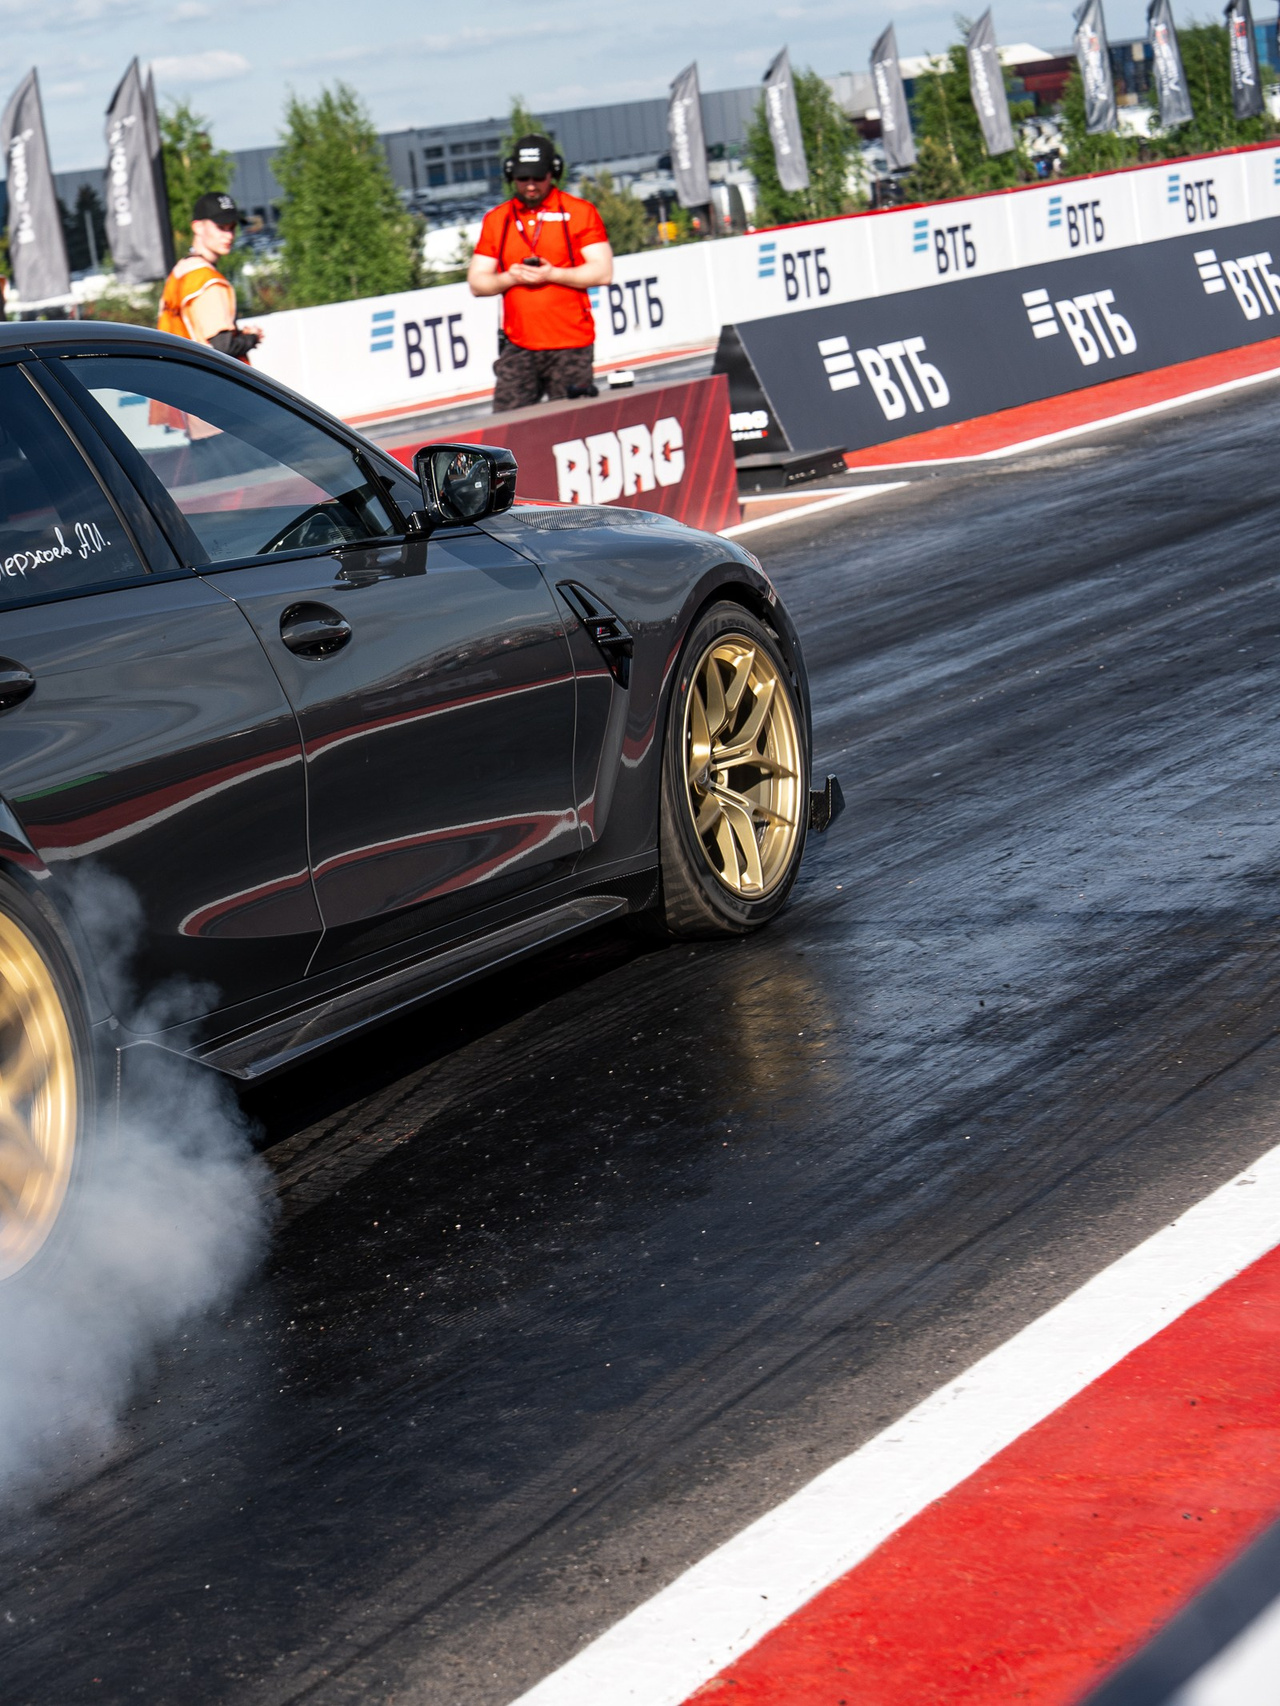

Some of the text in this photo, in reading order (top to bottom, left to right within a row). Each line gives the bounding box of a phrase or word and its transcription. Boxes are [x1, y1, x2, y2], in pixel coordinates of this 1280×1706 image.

[1066, 200, 1105, 248] ВТБ
[1184, 179, 1218, 223] ВТБ
[782, 247, 831, 301] ВТБ
[934, 223, 977, 275] ВТБ
[608, 276, 664, 336] ВТБ
[1055, 288, 1138, 367] ВТБ
[403, 313, 470, 379] ВТБ
[856, 335, 951, 421] ВТБ
[552, 416, 685, 505] RDRC
